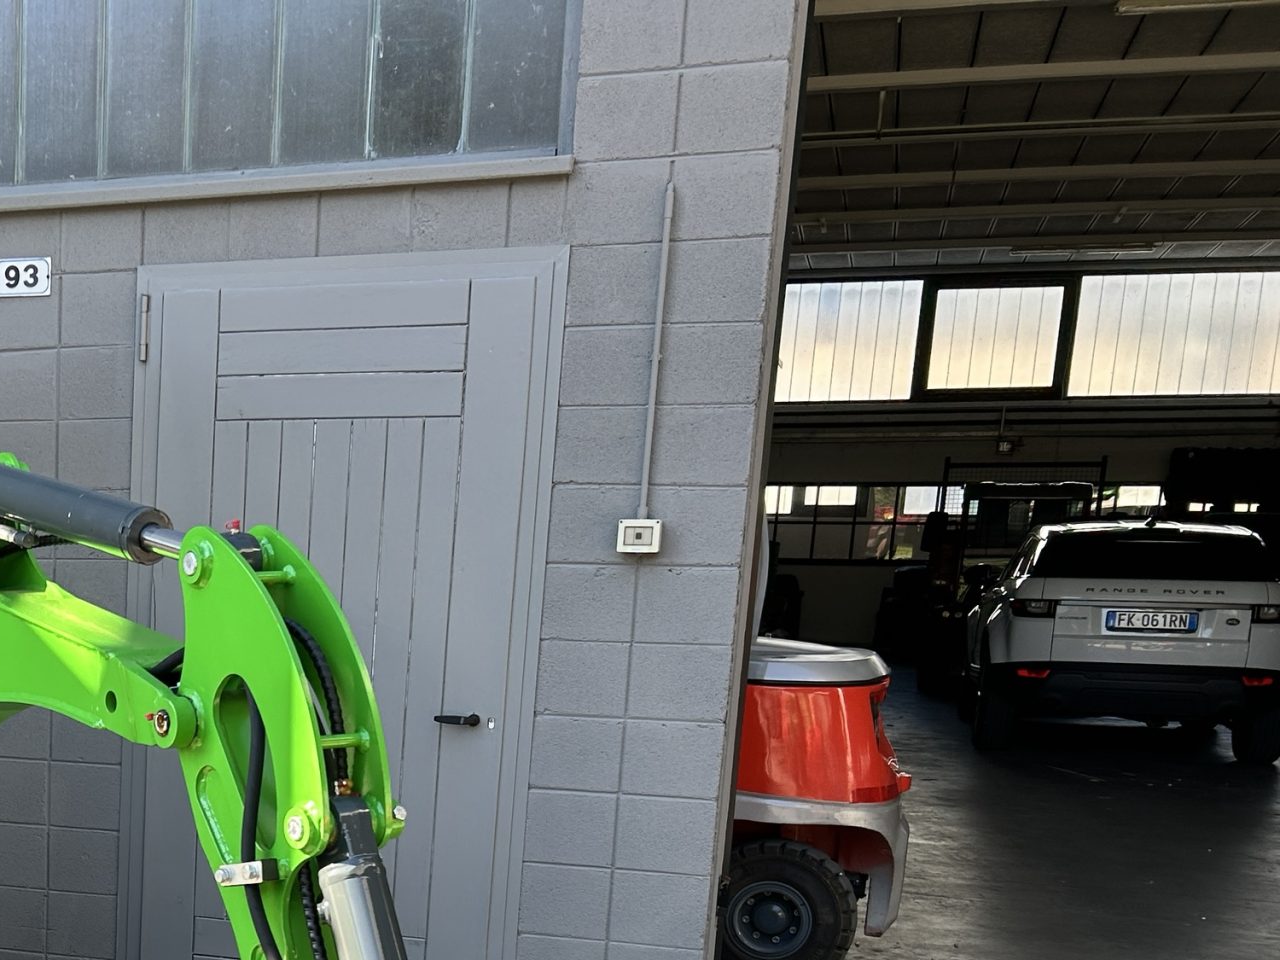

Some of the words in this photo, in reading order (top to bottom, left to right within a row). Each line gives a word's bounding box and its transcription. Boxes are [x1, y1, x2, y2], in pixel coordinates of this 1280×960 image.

[4, 264, 39, 289] 93
[1085, 586, 1149, 594] RANGE
[1163, 588, 1226, 596] ROVER
[1117, 613, 1135, 627] FK
